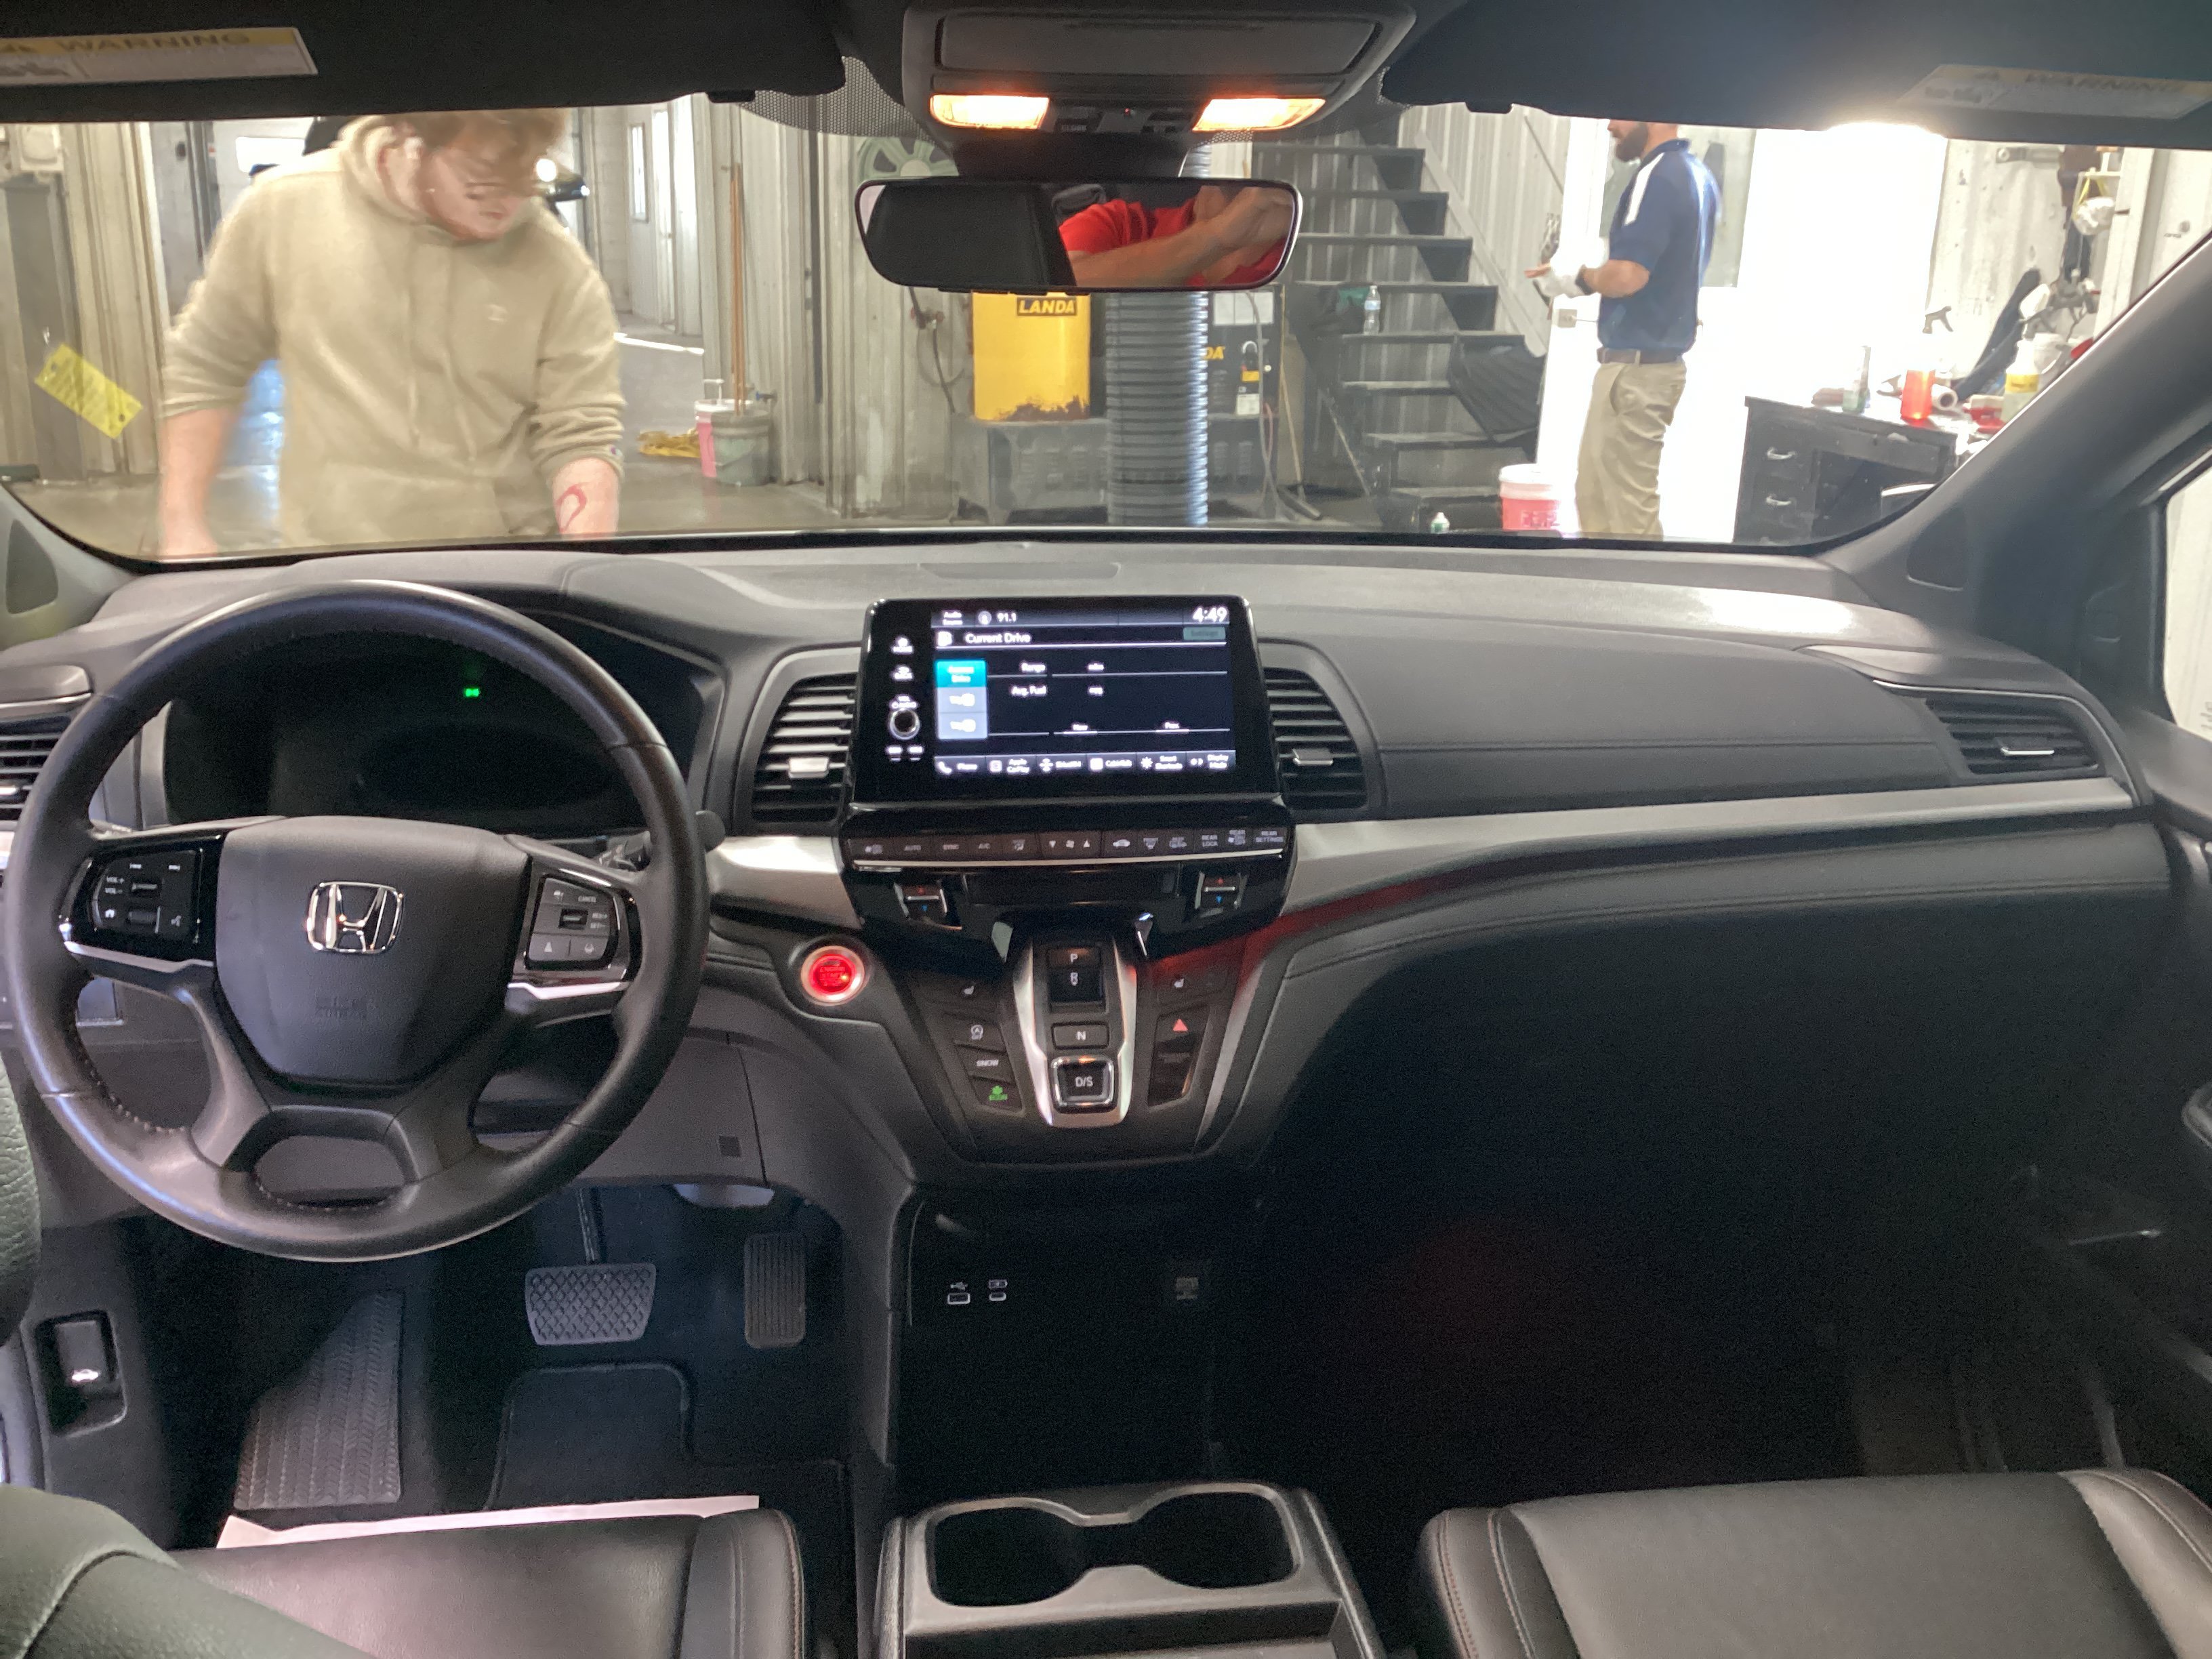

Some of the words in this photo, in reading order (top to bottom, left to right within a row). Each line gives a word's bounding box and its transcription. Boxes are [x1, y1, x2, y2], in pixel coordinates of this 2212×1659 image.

[56, 33, 249, 52] WARNING
[1019, 299, 1075, 314] LANDA
[997, 612, 1017, 623] 91.1
[1192, 607, 1227, 622] 4:49
[964, 633, 1003, 644] Current
[1004, 632, 1031, 643] Drive
[1029, 685, 1046, 695] Fuel
[1070, 954, 1078, 964] P
[1076, 1031, 1086, 1040] N
[1075, 1076, 1093, 1088] D/S
